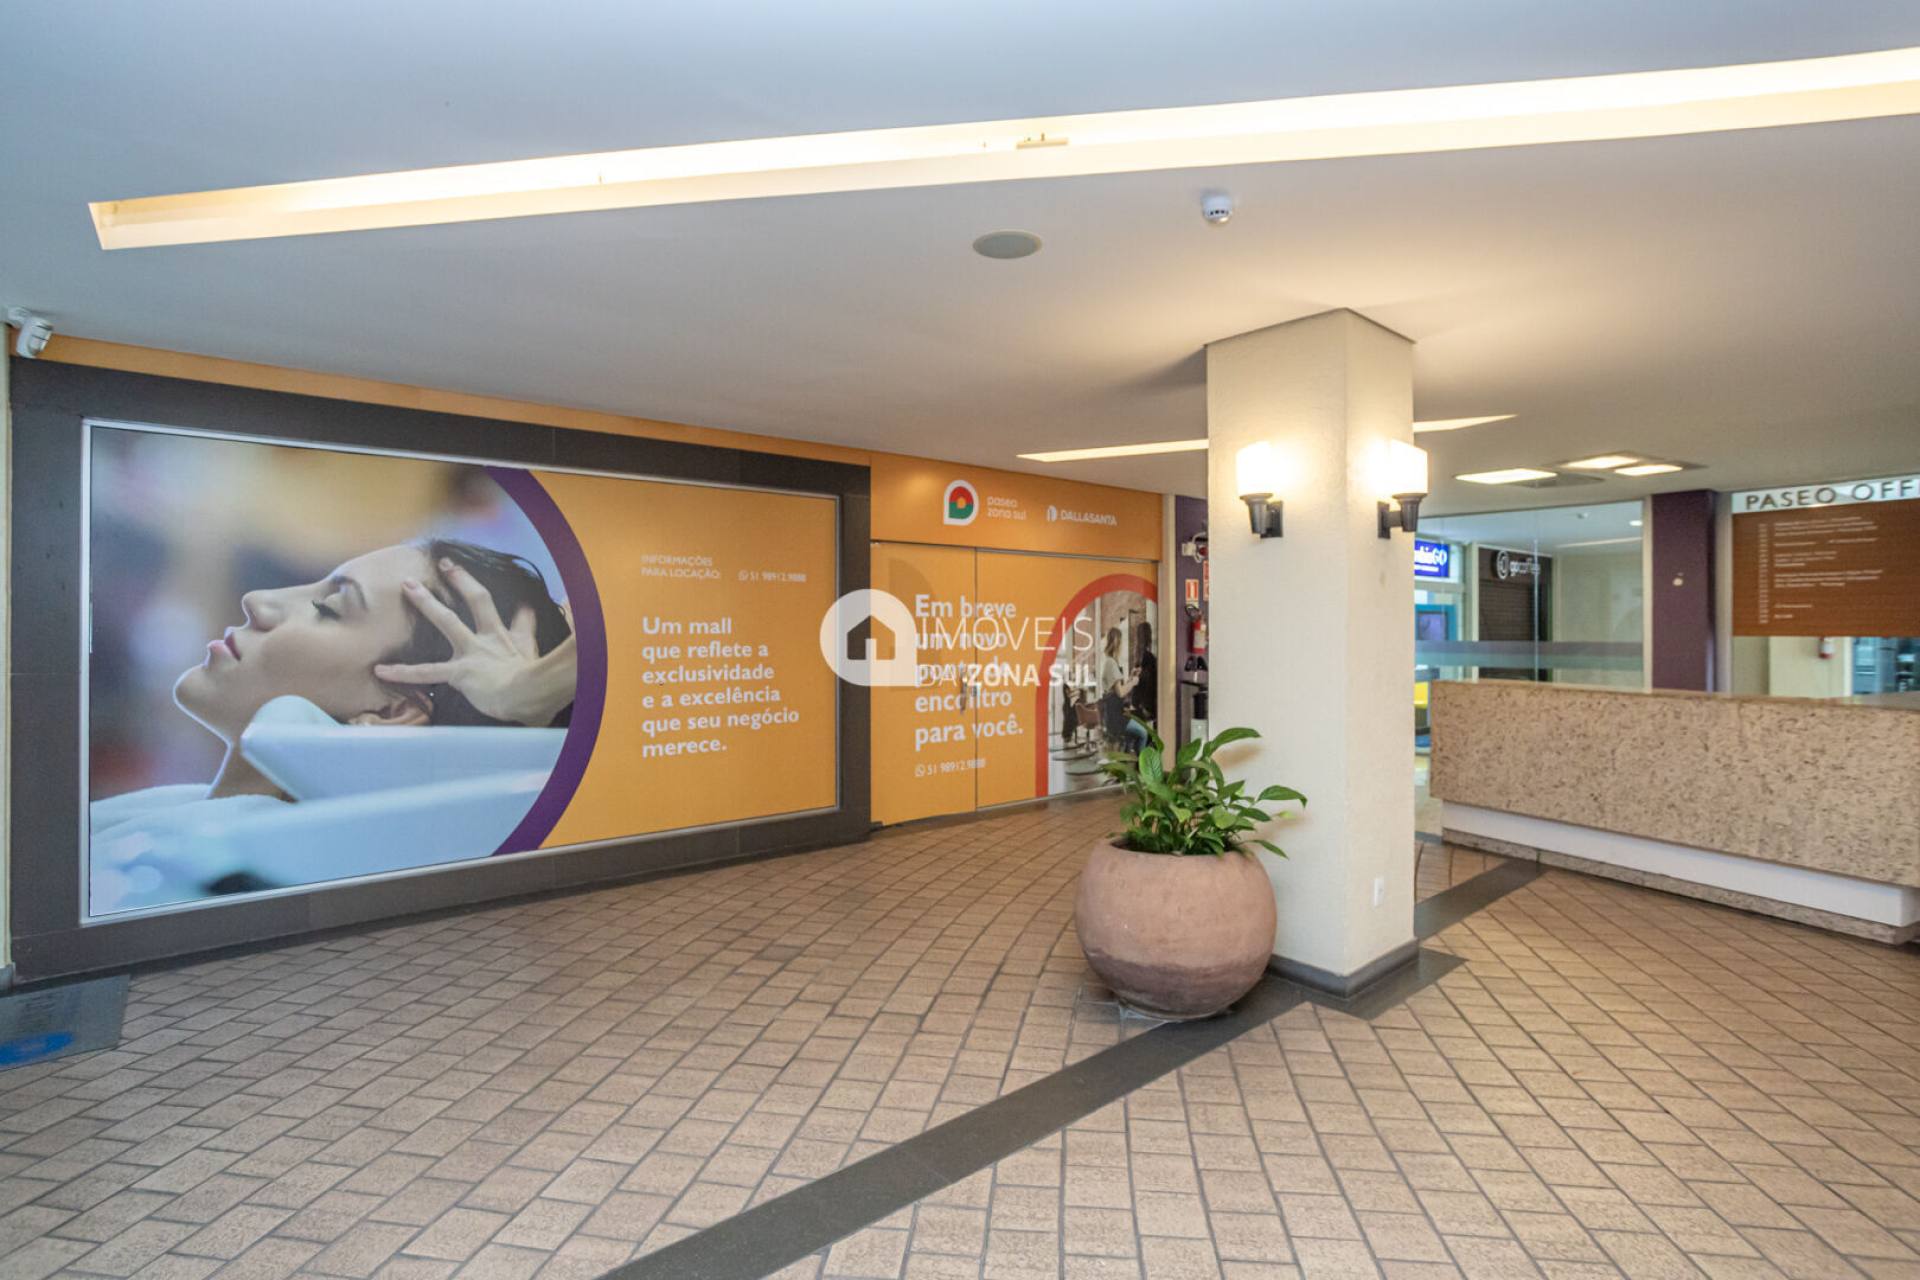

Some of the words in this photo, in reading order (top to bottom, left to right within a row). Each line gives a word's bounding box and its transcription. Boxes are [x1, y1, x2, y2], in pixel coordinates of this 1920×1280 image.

[1746, 487, 1837, 510] PASEO
[1060, 509, 1118, 526] DALLASANTA
[640, 555, 713, 567] INFORMAÇÕES
[640, 567, 667, 577] PARA
[670, 568, 720, 579] LOCAÇÃO
[915, 594, 953, 617] Em
[960, 595, 1017, 618] breve
[642, 616, 682, 634] Um
[689, 616, 732, 634] mall
[960, 632, 1007, 649] novo
[642, 644, 680, 664] que
[687, 640, 752, 659] reflete
[758, 644, 769, 657] a
[642, 664, 775, 684] exclusividade
[642, 695, 655, 708] e
[661, 694, 673, 707] a
[679, 686, 781, 706] excelência
[642, 717, 681, 737] que
[687, 714, 721, 730] seu
[727, 707, 800, 730] negócio
[915, 723, 966, 752] para
[972, 714, 1023, 737] você.
[642, 738, 728, 758] merece.
